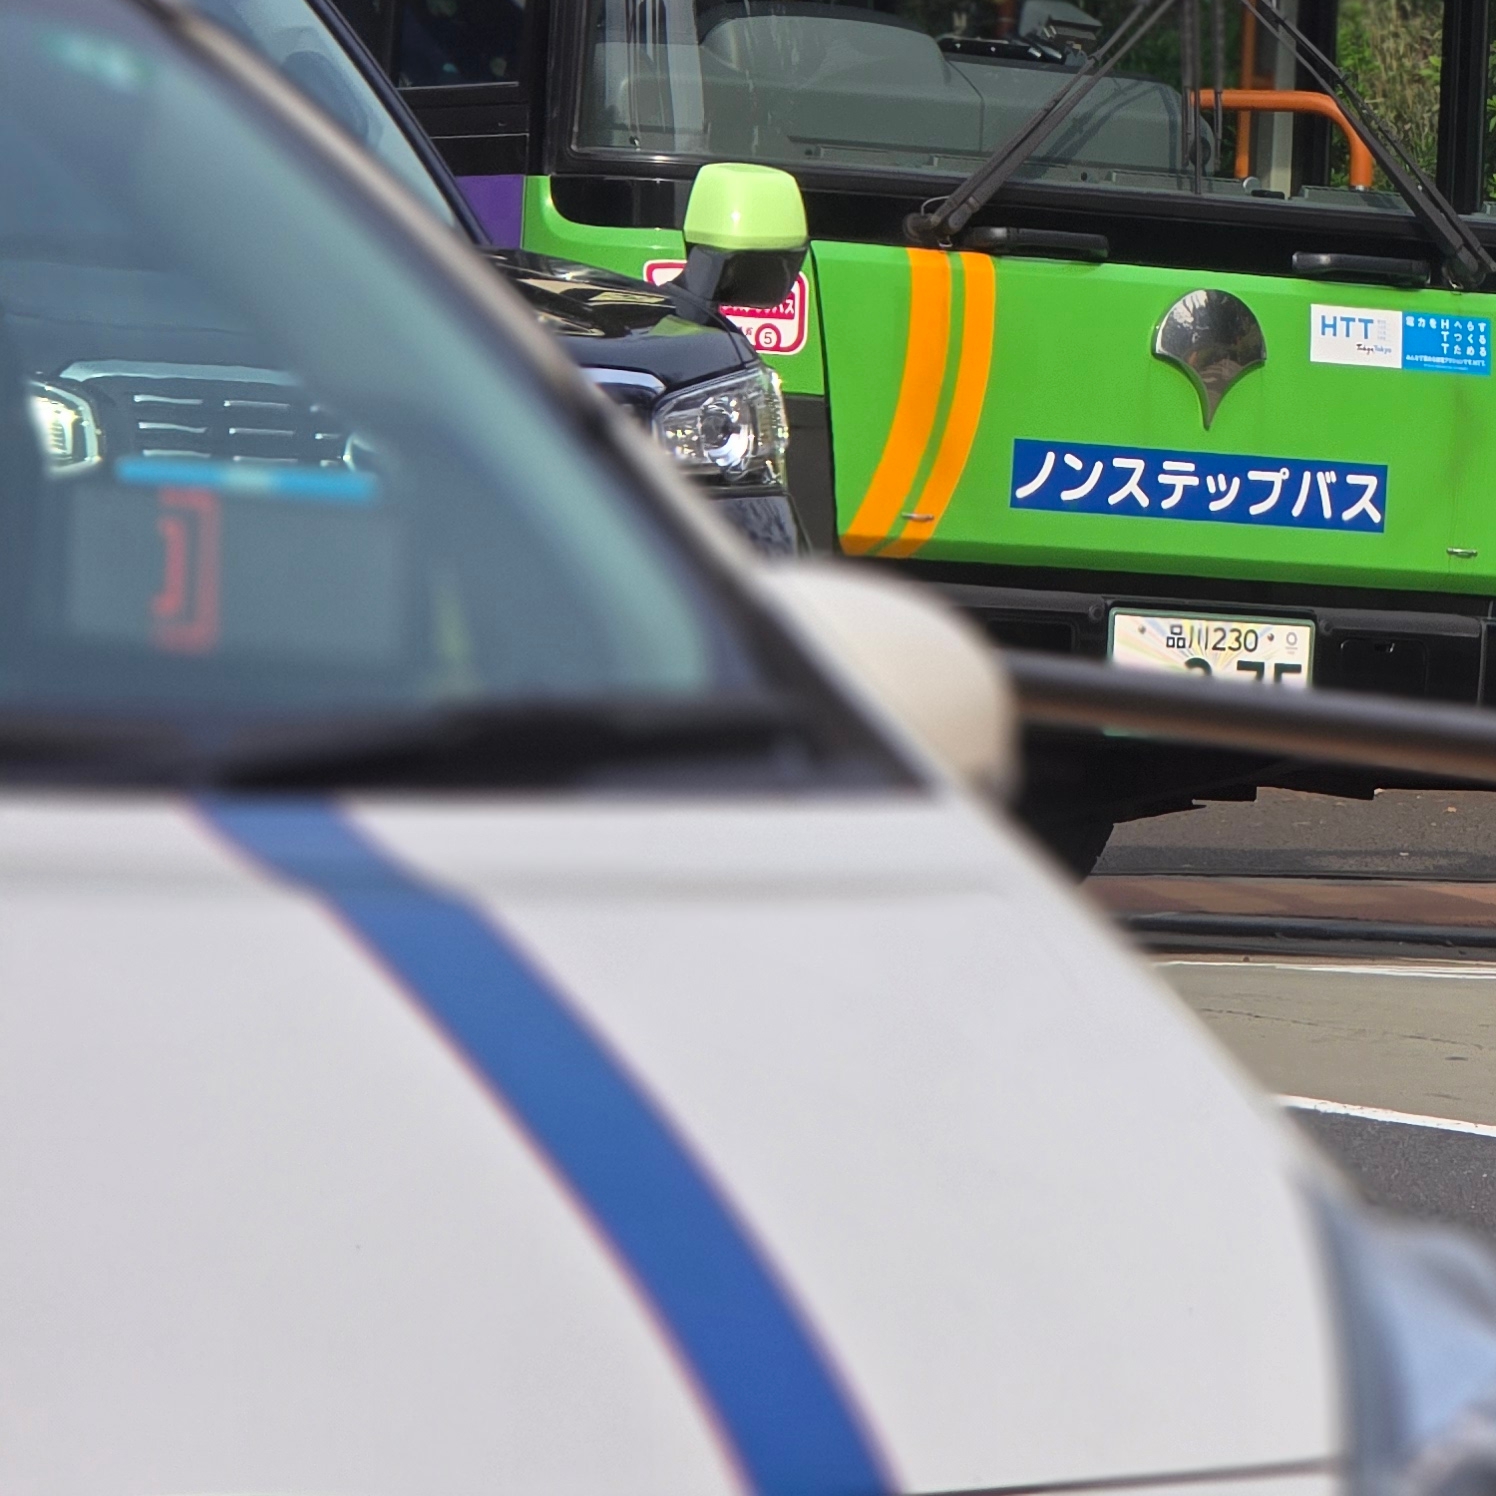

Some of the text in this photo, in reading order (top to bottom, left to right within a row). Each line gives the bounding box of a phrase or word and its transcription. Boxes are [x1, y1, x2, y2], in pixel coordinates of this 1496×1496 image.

[763, 332, 773, 344] 5
[1321, 315, 1374, 340] HTT
[1015, 451, 1381, 524] ノンステップバス
[1166, 624, 1259, 653] 品川230
